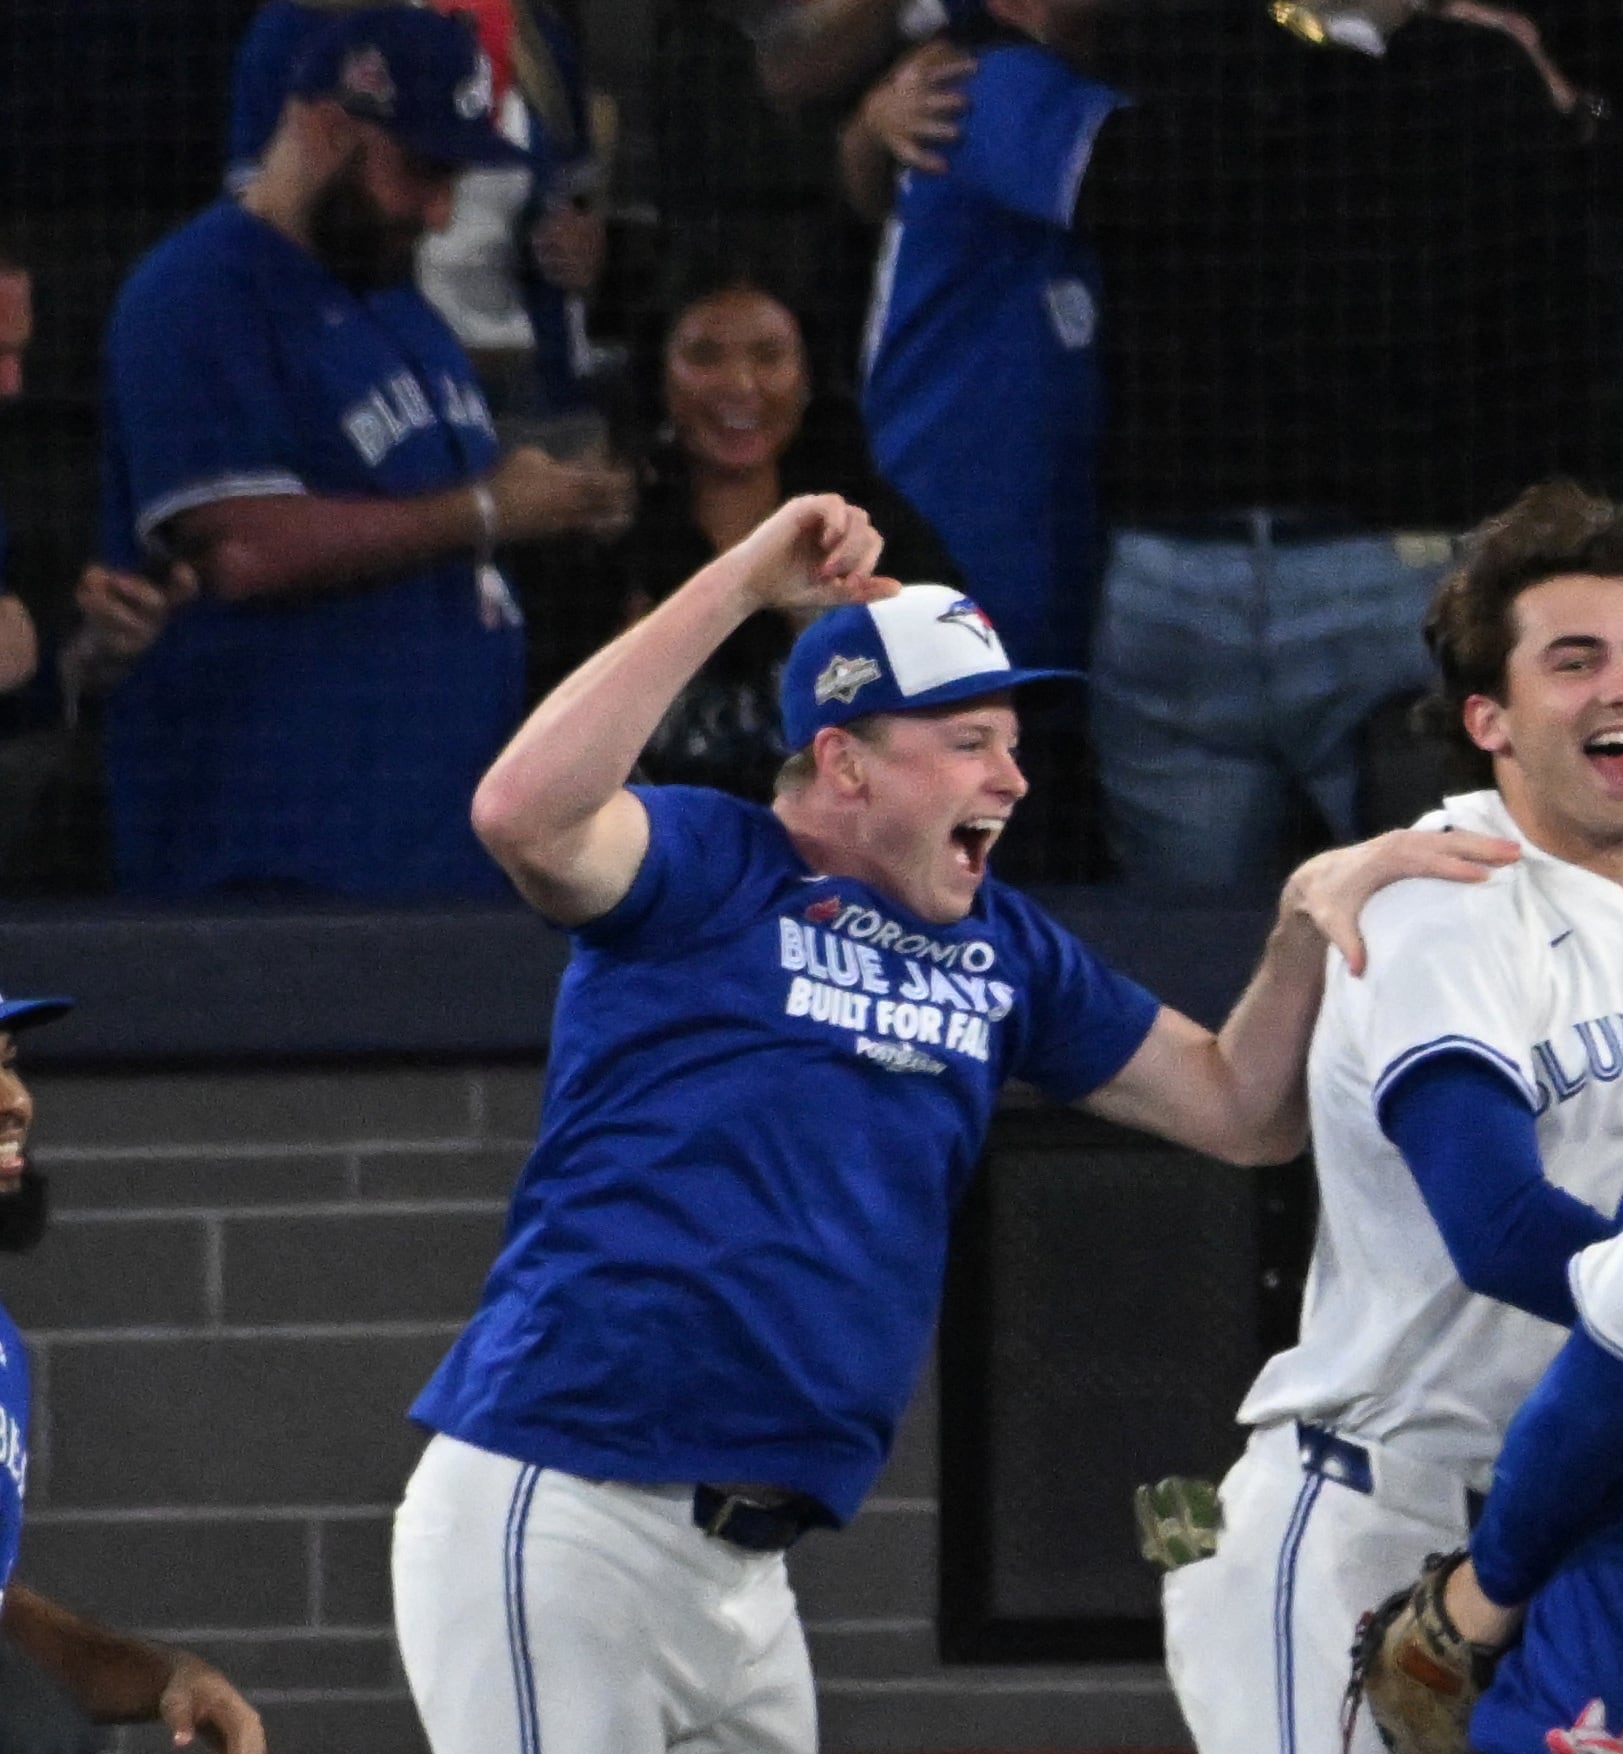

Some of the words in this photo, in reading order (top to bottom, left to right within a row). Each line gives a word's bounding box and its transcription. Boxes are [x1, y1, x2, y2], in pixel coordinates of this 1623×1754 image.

[780, 916, 890, 994] BLUE
[899, 960, 1014, 1022] JAYS
[786, 976, 872, 1031] BUILT
[876, 1000, 944, 1044] FOR
